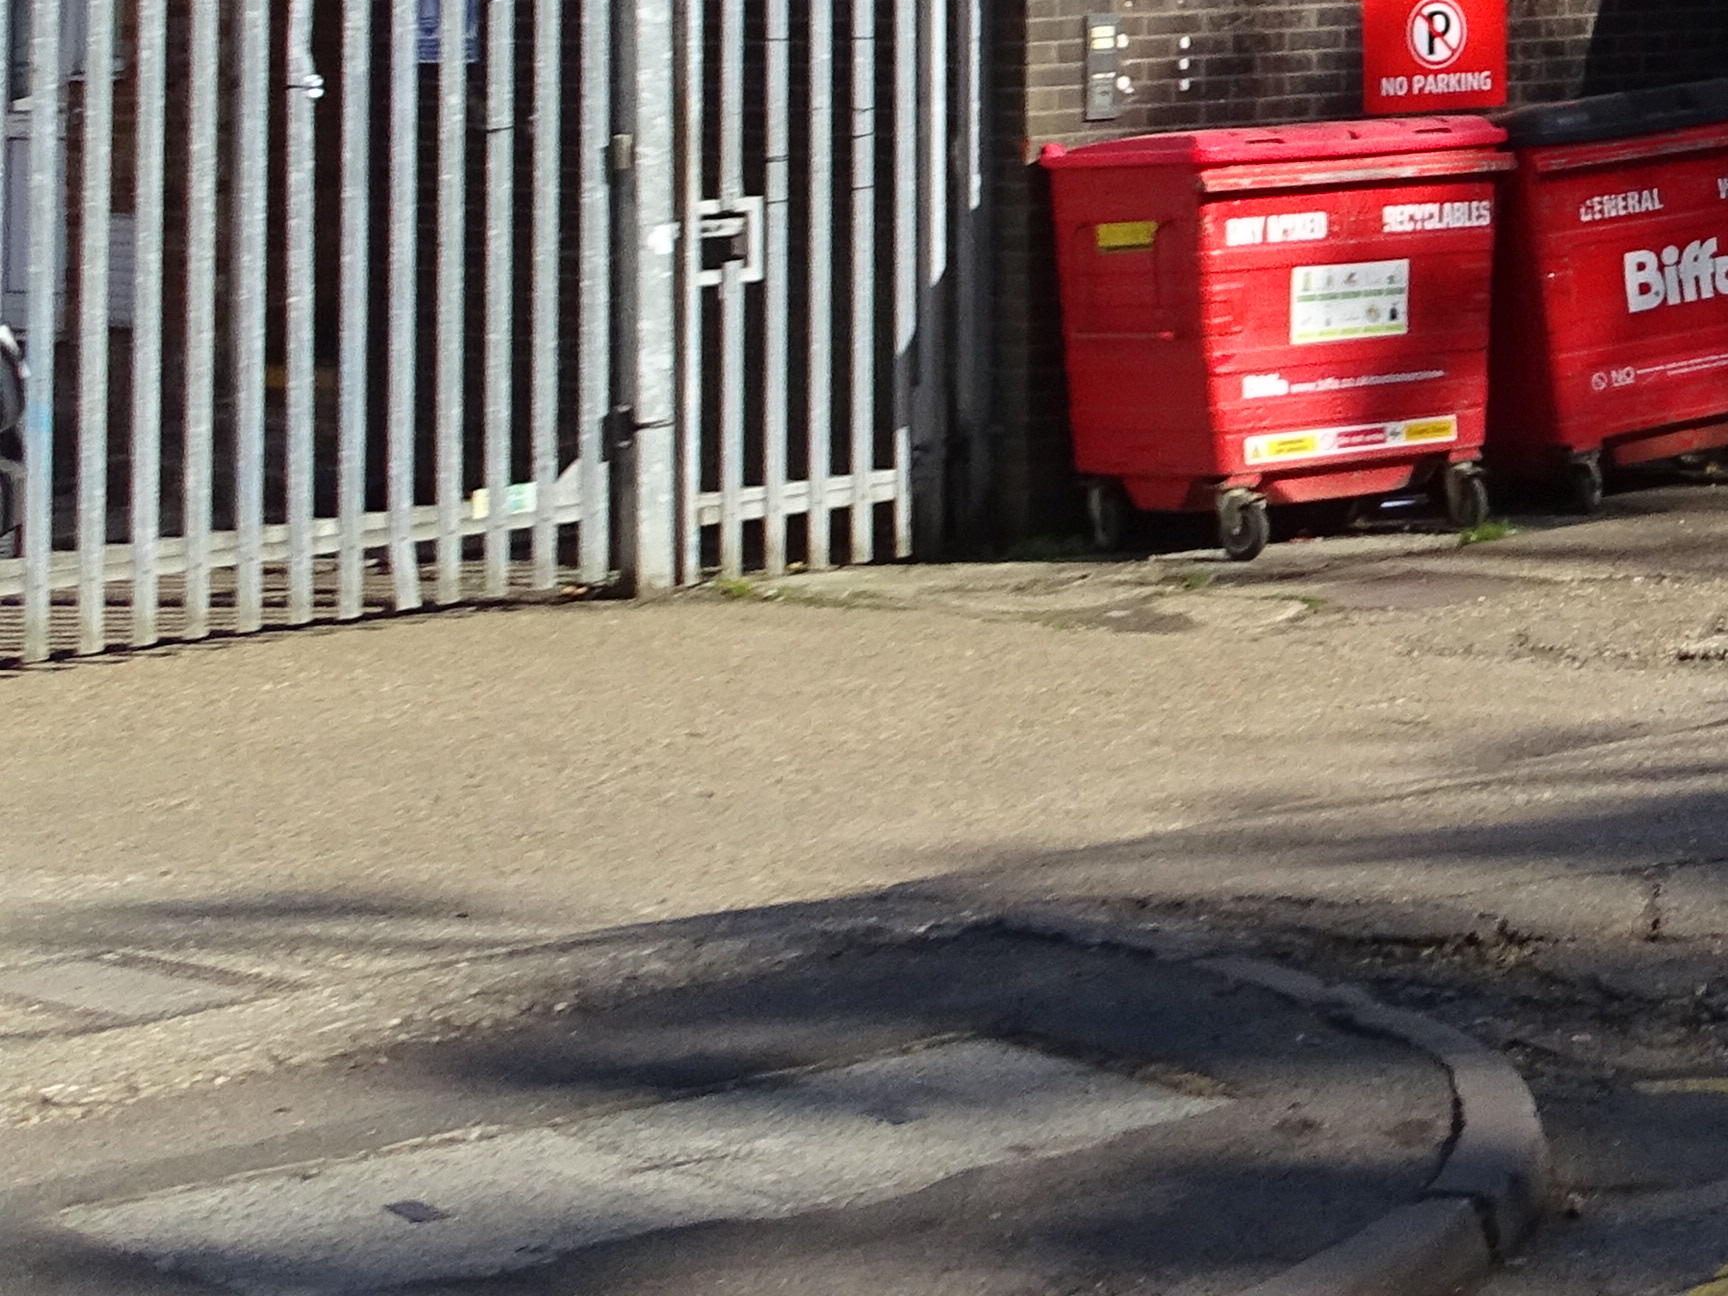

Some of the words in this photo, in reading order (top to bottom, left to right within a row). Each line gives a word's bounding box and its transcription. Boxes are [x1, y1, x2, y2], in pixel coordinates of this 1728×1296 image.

[1380, 76, 1408, 96] NO
[1412, 71, 1492, 95] PARKING
[1382, 200, 1491, 233] RECYCLABLES
[1579, 188, 1664, 222] GENERAL
